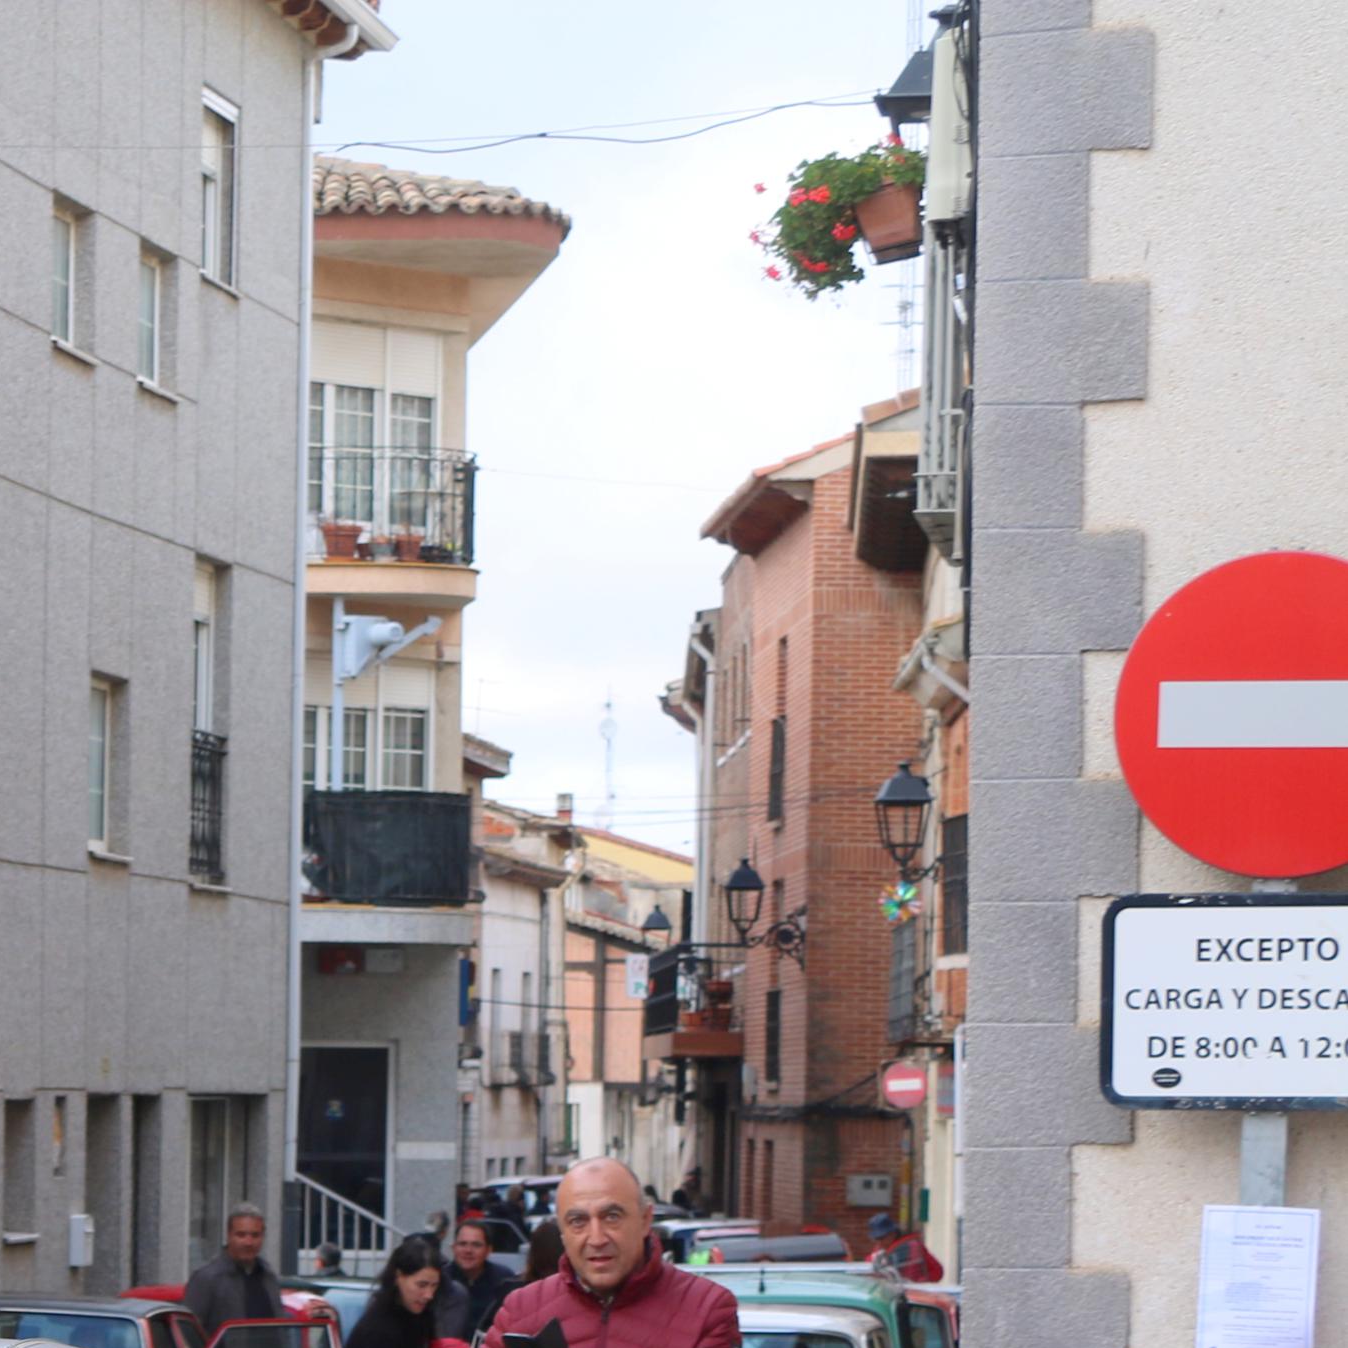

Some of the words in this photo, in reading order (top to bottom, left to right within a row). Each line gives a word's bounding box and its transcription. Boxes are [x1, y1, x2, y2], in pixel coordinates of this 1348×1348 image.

[1195, 937, 1340, 962] EXCEPTO
[1125, 988, 1224, 1010] CARGA
[1232, 988, 1249, 1010] Y
[1147, 1036, 1186, 1059] DE
[1269, 1036, 1287, 1059] A
[1298, 1036, 1348, 1059] 12:
